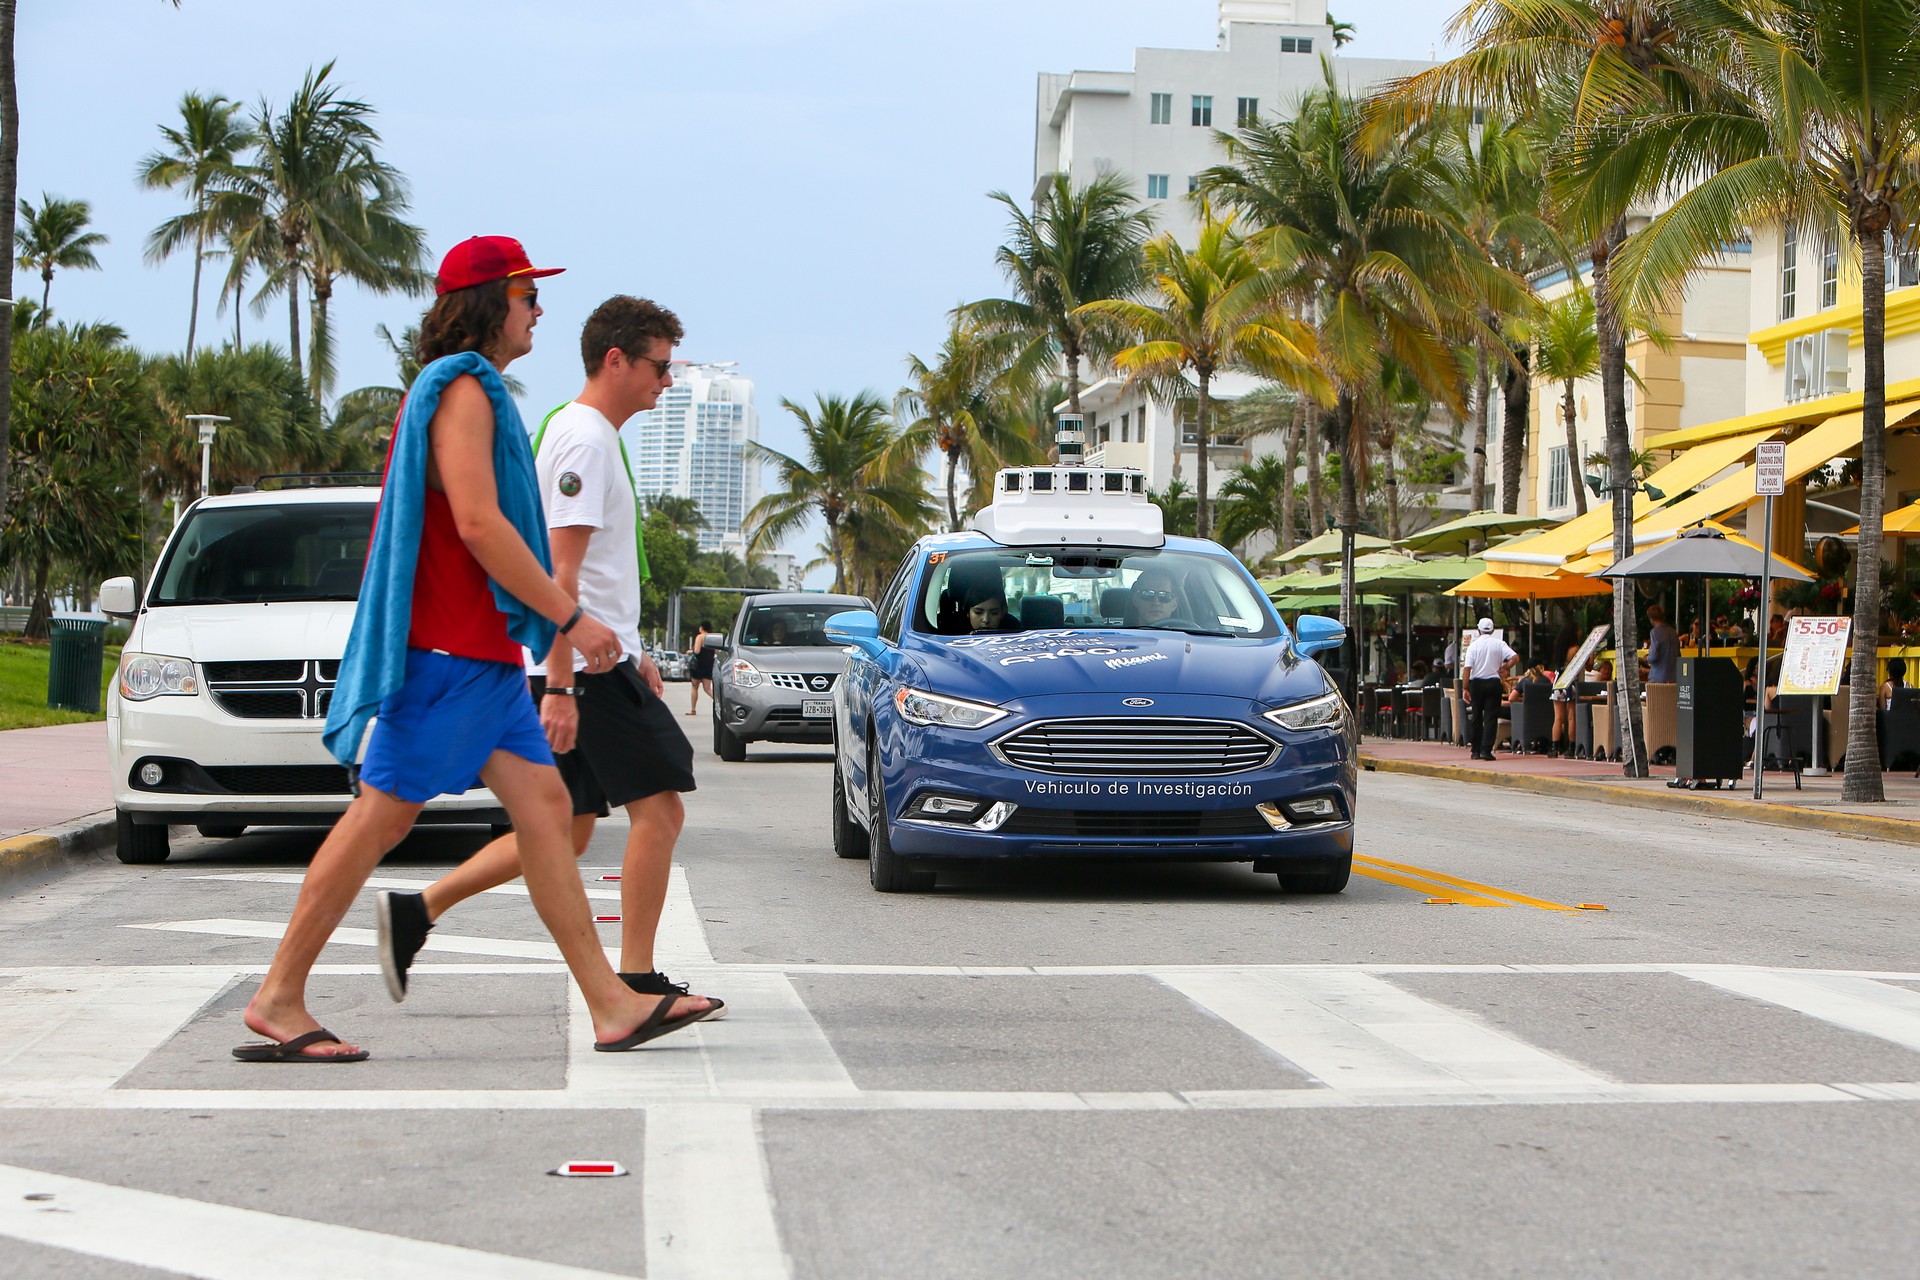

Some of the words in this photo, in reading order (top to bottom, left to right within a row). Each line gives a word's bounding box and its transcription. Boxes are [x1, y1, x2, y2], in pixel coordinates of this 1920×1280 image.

[1759, 456, 1773, 464] LOADING
[1774, 456, 1782, 464] ZONE
[1759, 468, 1767, 476] VALET
[1768, 468, 1782, 476] PARKING
[1767, 478, 1778, 486] HOURS
[929, 553, 946, 564] 31
[1795, 622, 1839, 635] $5.50
[945, 630, 1079, 648] Ford
[1103, 652, 1168, 670] Miami
[1108, 780, 1129, 795] de
[1137, 781, 1252, 798] Investigación
